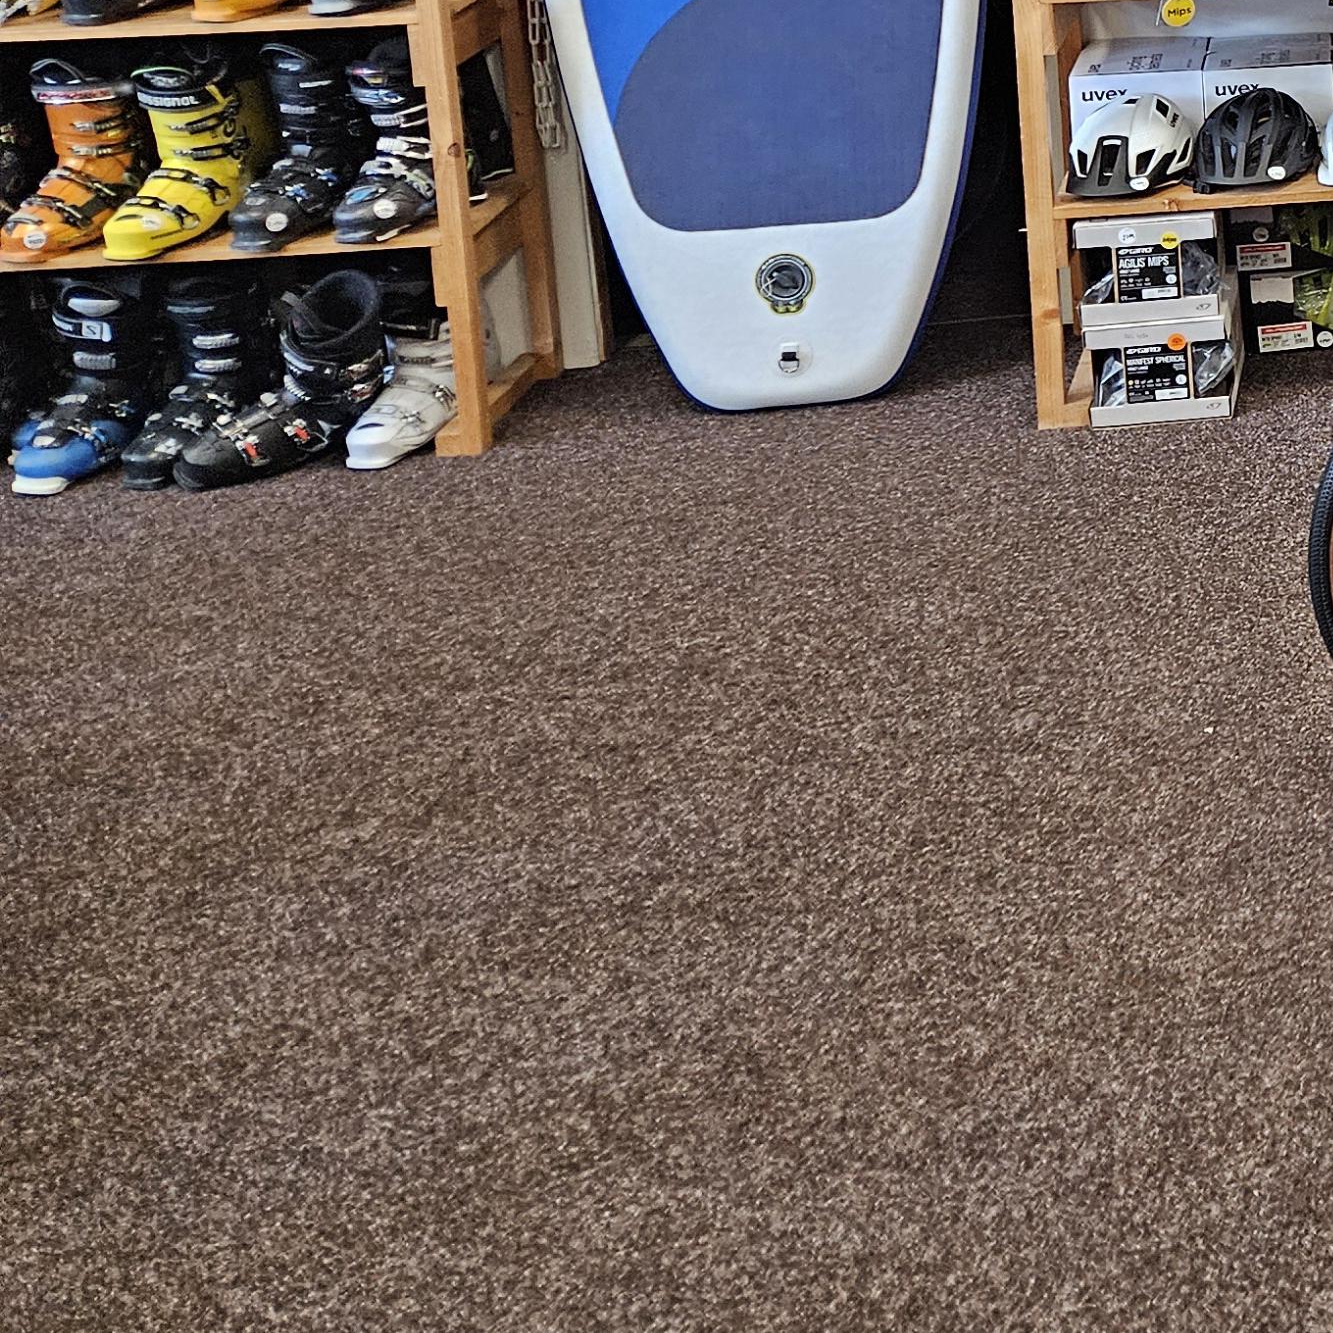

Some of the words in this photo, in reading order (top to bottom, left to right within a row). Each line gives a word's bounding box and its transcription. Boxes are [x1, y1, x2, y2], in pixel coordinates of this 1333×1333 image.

[1168, 7, 1192, 17] Mips
[1081, 88, 1128, 102] uvex
[1214, 83, 1260, 97] uvex
[1118, 257, 1146, 269] AGILIS
[1147, 255, 1169, 267] MIPS
[1155, 354, 1186, 364] SPHERICAL
